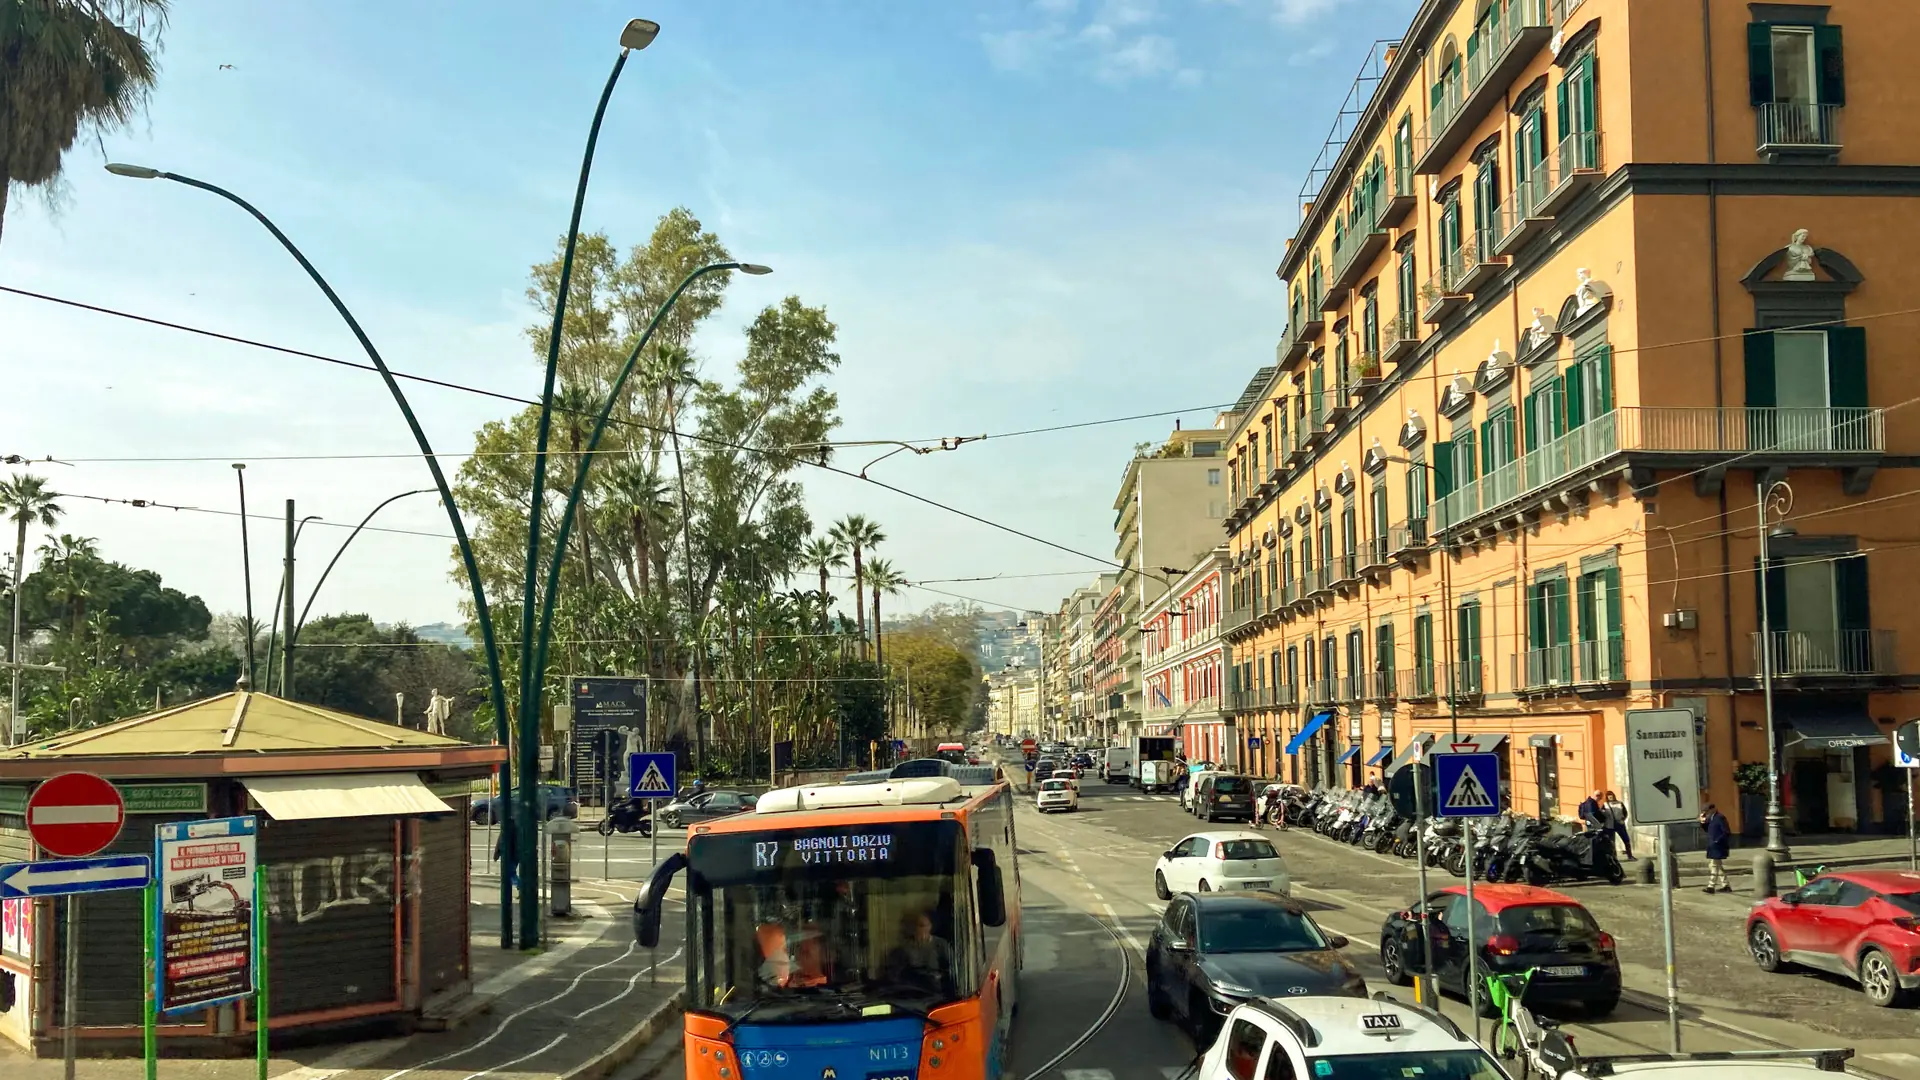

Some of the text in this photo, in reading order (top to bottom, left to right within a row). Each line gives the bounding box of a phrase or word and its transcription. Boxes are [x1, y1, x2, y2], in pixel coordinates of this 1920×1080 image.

[1643, 748, 1683, 760] Posillipo
[794, 835, 848, 851] BAGNOLI
[755, 841, 779, 867] R7
[801, 847, 889, 864] VITTORIA
[1363, 1016, 1399, 1027] TAXI
[870, 1047, 909, 1060] N113
